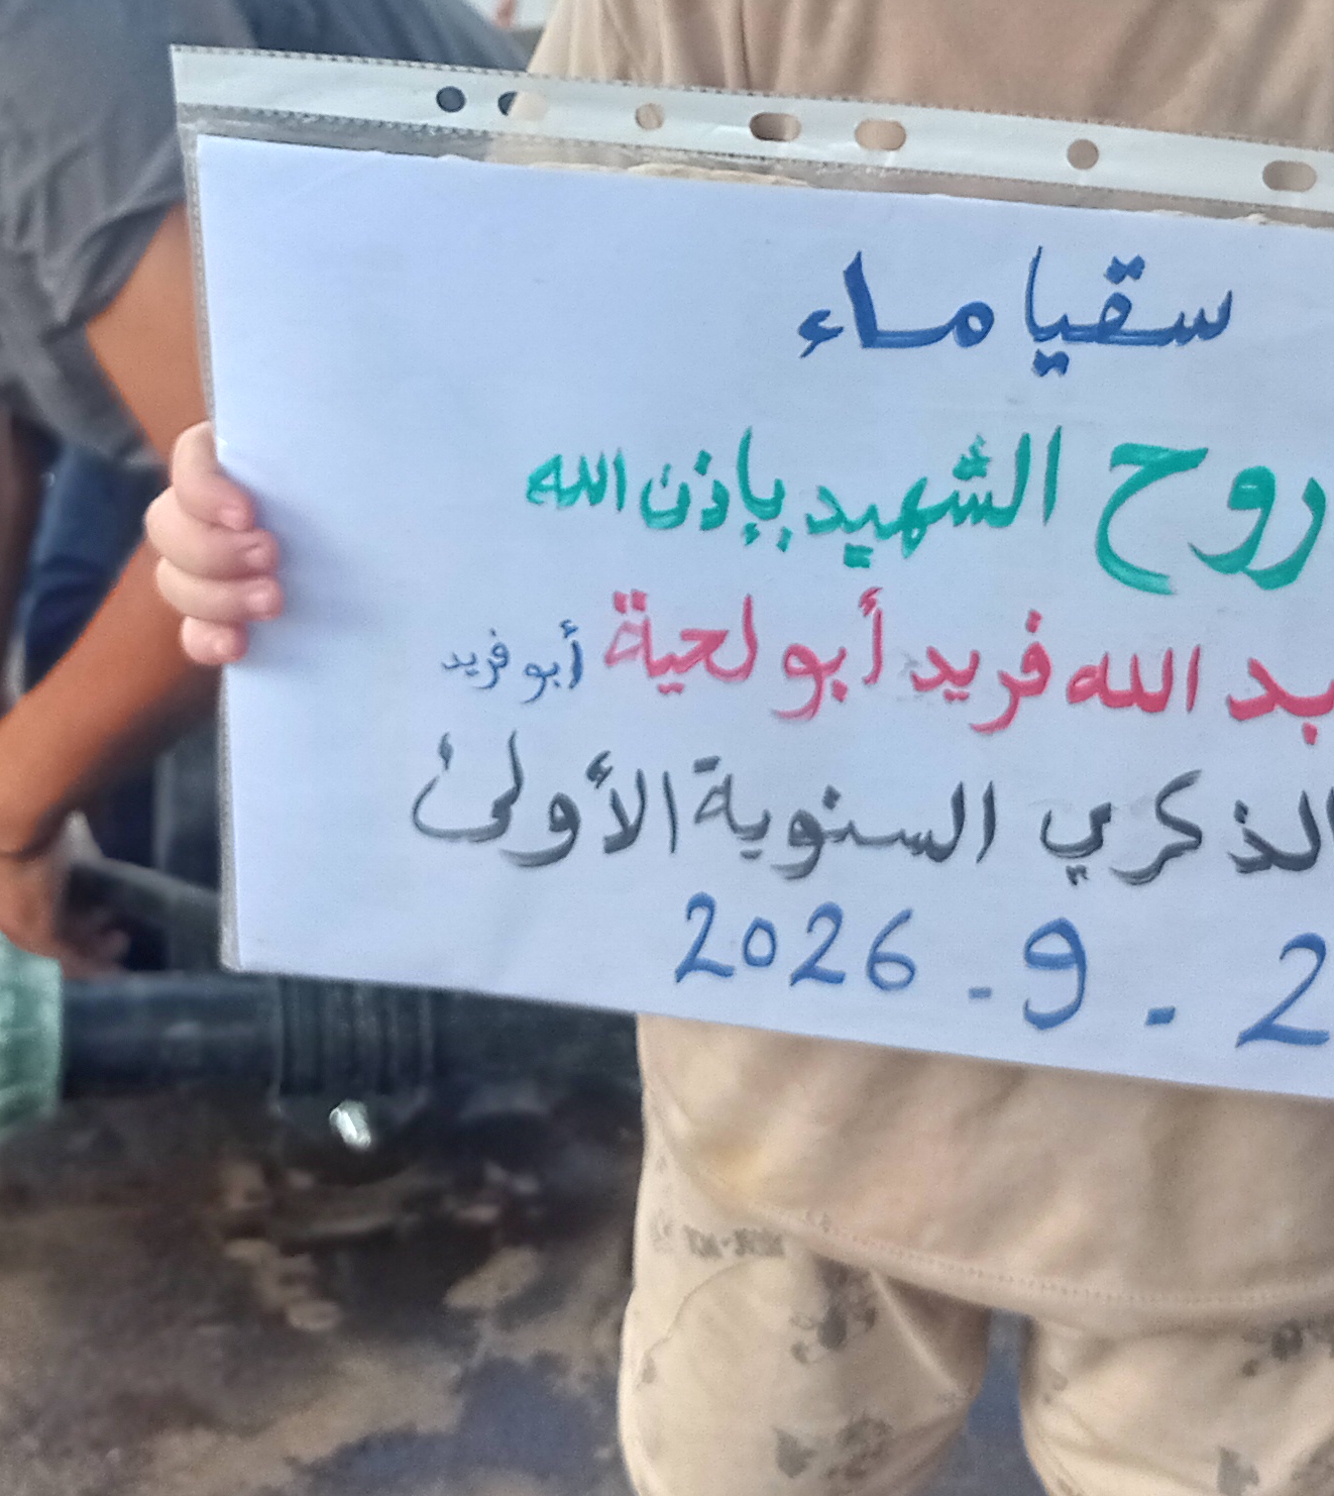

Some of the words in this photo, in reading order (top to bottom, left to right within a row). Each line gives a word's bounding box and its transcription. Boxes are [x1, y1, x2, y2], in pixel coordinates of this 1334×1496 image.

[797, 250, 995, 359] ماء
[1024, 245, 1233, 378] سقيا
[524, 447, 628, 513] الله
[639, 427, 794, 554] بإذن
[805, 425, 1063, 569] الشهيد
[1095, 442, 1329, 596] روح
[440, 626, 511, 691] فريد
[521, 618, 585, 705] أبو
[604, 588, 758, 696] لحية
[768, 586, 884, 722] أبو
[909, 609, 1052, 736] فريد
[1065, 644, 1201, 715] الله
[691, 754, 997, 881] السنوية
[674, 892, 918, 993] 2026
[1022, 917, 1089, 1033] 9
[1235, 932, 1333, 1050] 2
